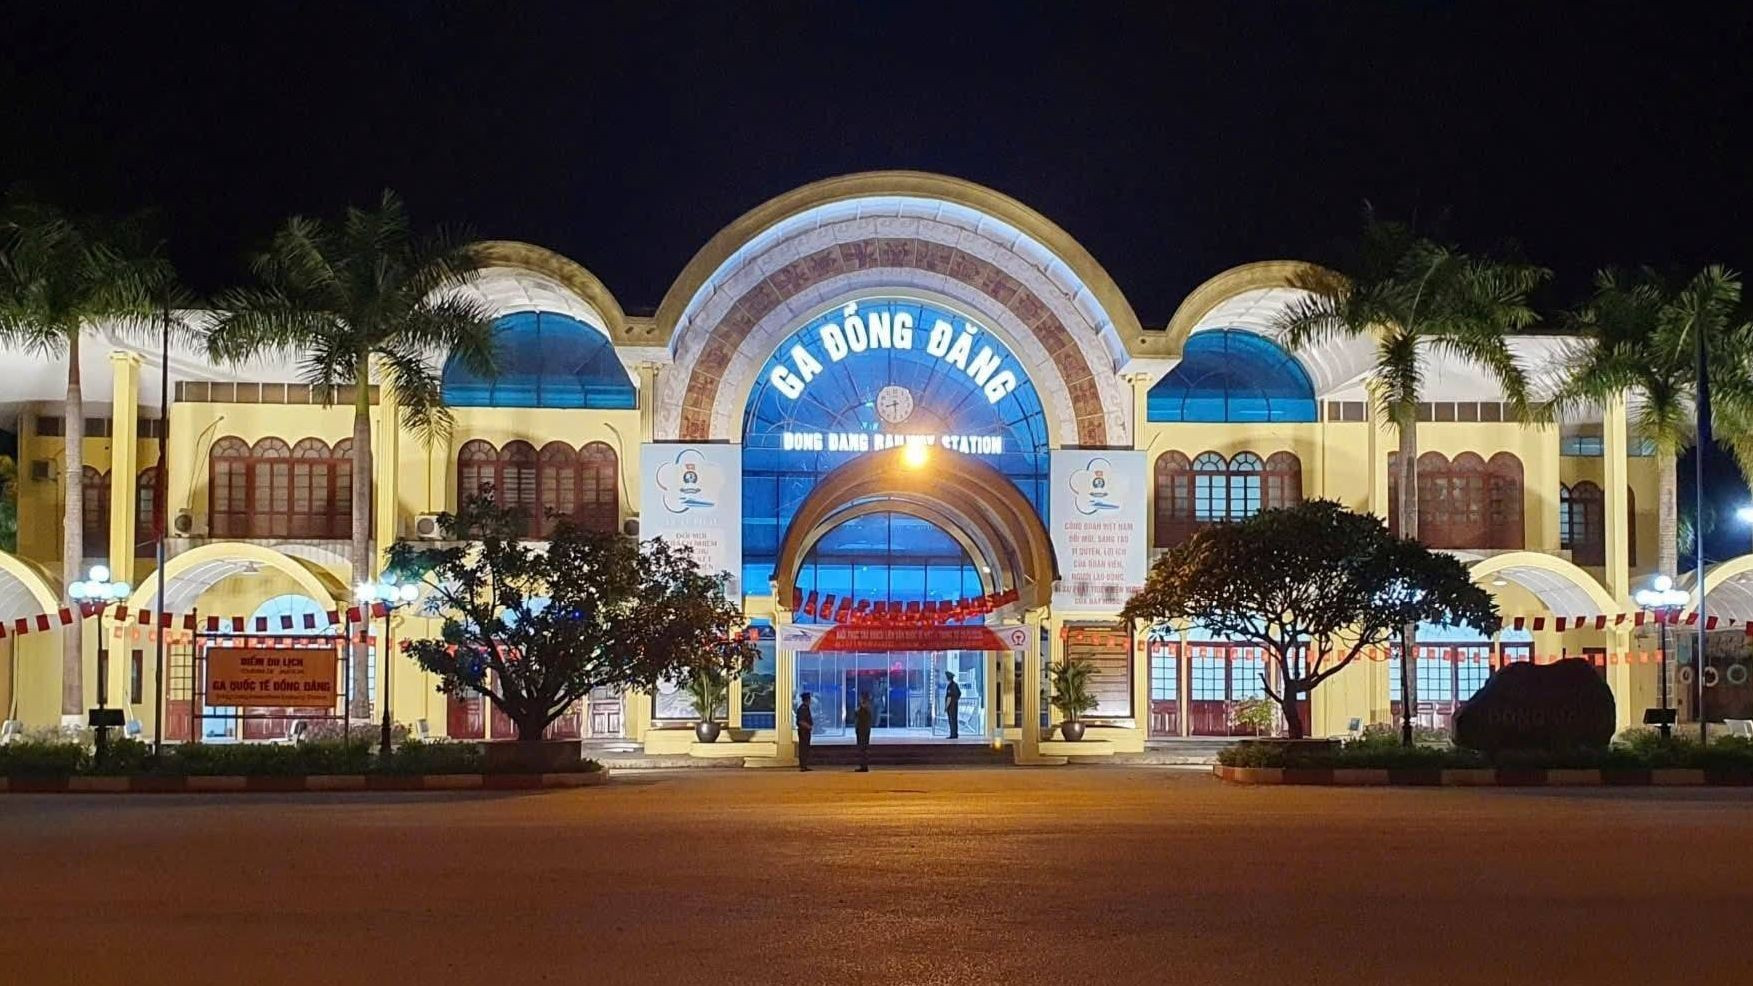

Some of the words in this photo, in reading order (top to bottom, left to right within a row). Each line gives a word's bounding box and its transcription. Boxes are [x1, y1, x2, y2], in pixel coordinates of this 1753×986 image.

[771, 344, 824, 400] GA
[926, 319, 1017, 404] ĐĂNG
[783, 431, 823, 451] DONG
[828, 432, 869, 452] DANG
[267, 657, 280, 667] DU
[212, 680, 226, 692] GA
